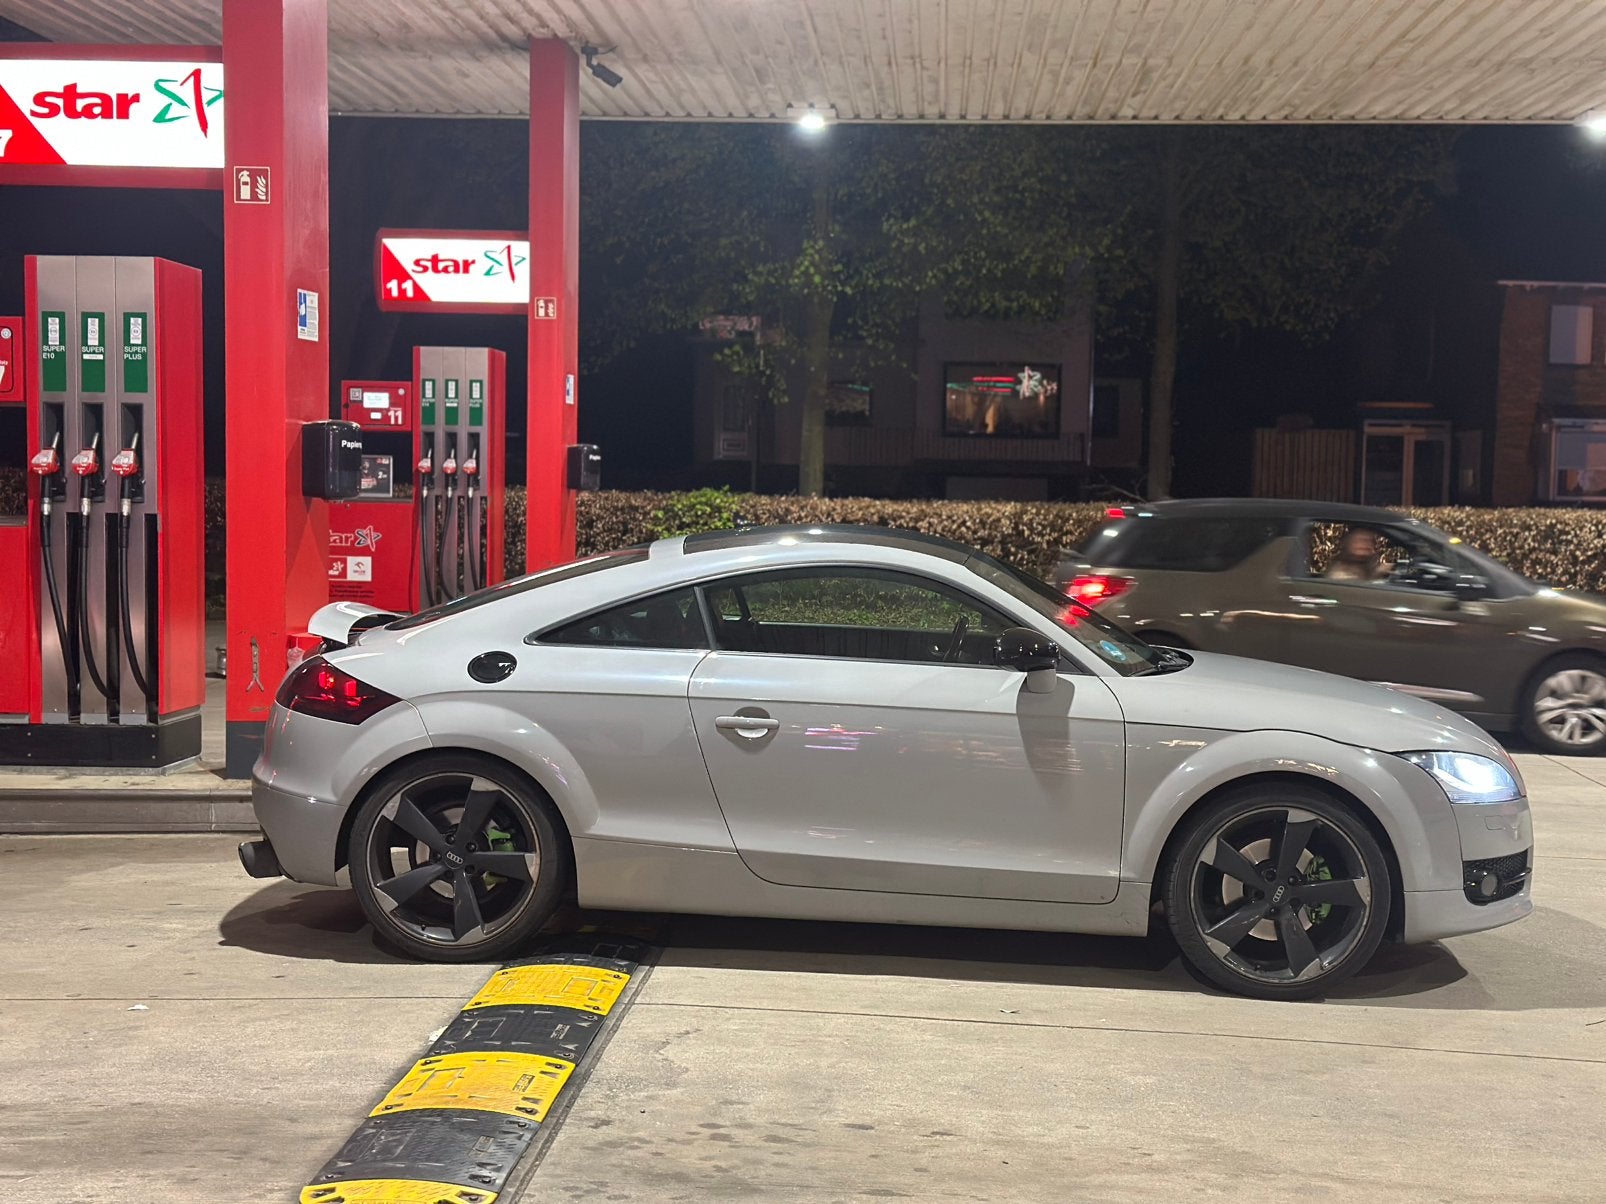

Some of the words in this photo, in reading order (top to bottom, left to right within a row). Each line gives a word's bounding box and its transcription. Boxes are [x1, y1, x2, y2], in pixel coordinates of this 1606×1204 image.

[30, 83, 140, 119] star
[411, 253, 475, 274] star
[386, 279, 414, 298] 11
[388, 410, 402, 425] 11
